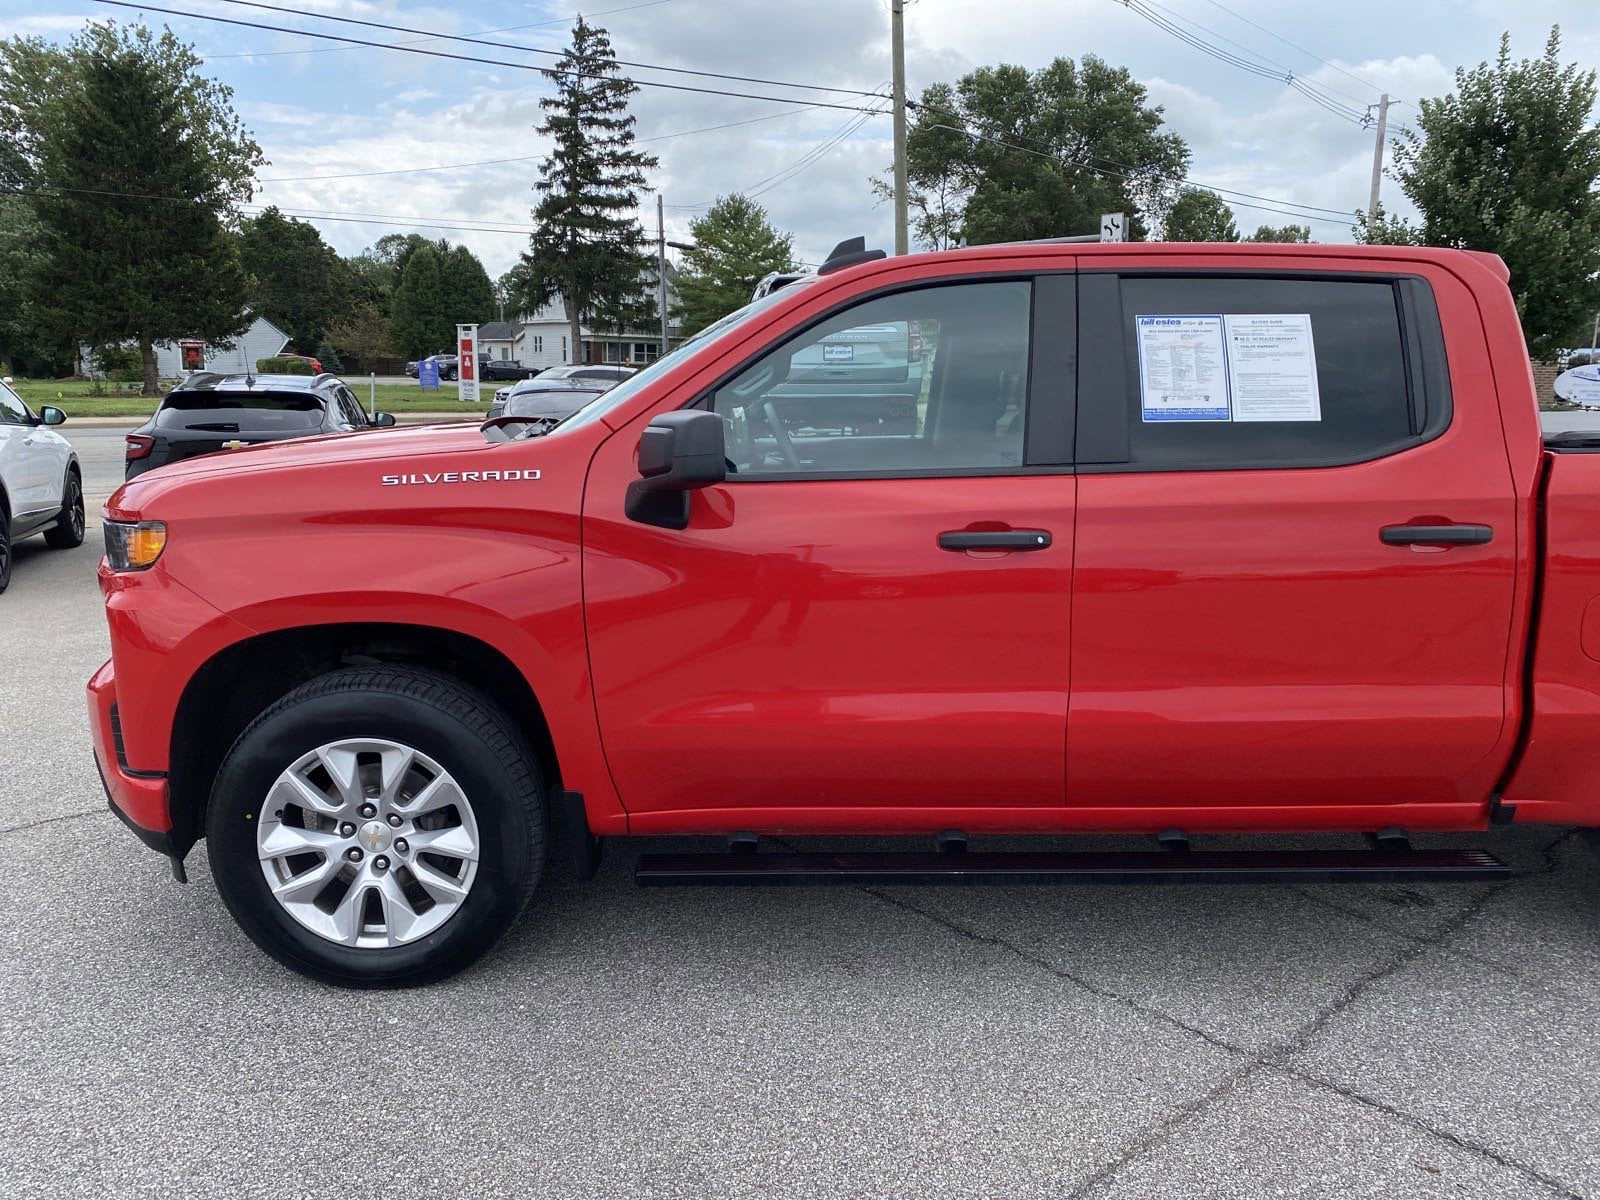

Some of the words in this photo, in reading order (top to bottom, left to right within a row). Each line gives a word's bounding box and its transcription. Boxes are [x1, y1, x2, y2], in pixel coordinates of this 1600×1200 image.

[1140, 318, 1155, 326] bill
[1155, 318, 1182, 326] estes
[381, 469, 541, 486] SILVERADO
